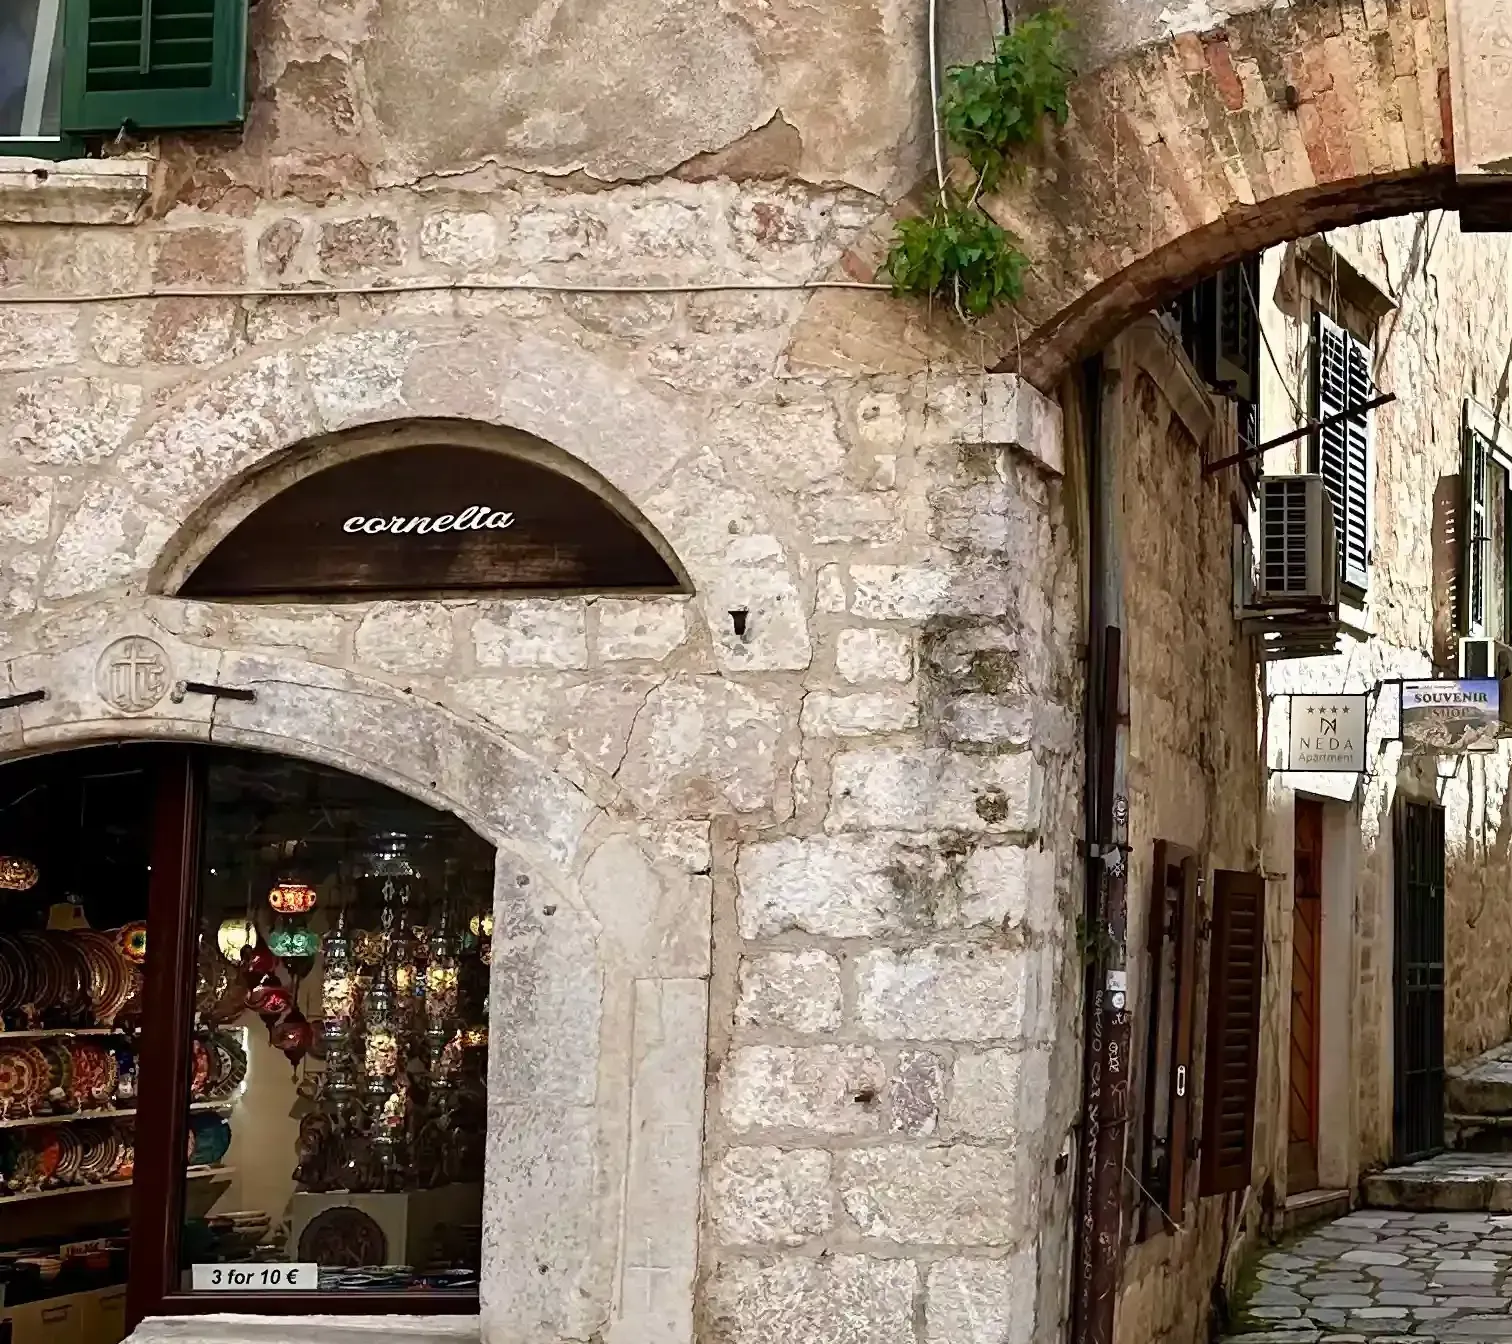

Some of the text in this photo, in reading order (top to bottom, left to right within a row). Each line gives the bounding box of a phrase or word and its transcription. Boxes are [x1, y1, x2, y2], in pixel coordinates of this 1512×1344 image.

[342, 505, 516, 535] cornelia
[1413, 692, 1489, 703] SOUVENIR
[1300, 737, 1353, 751] NEDA
[1298, 752, 1354, 764] Apartment
[211, 1269, 299, 1285] 3 for 10 €
